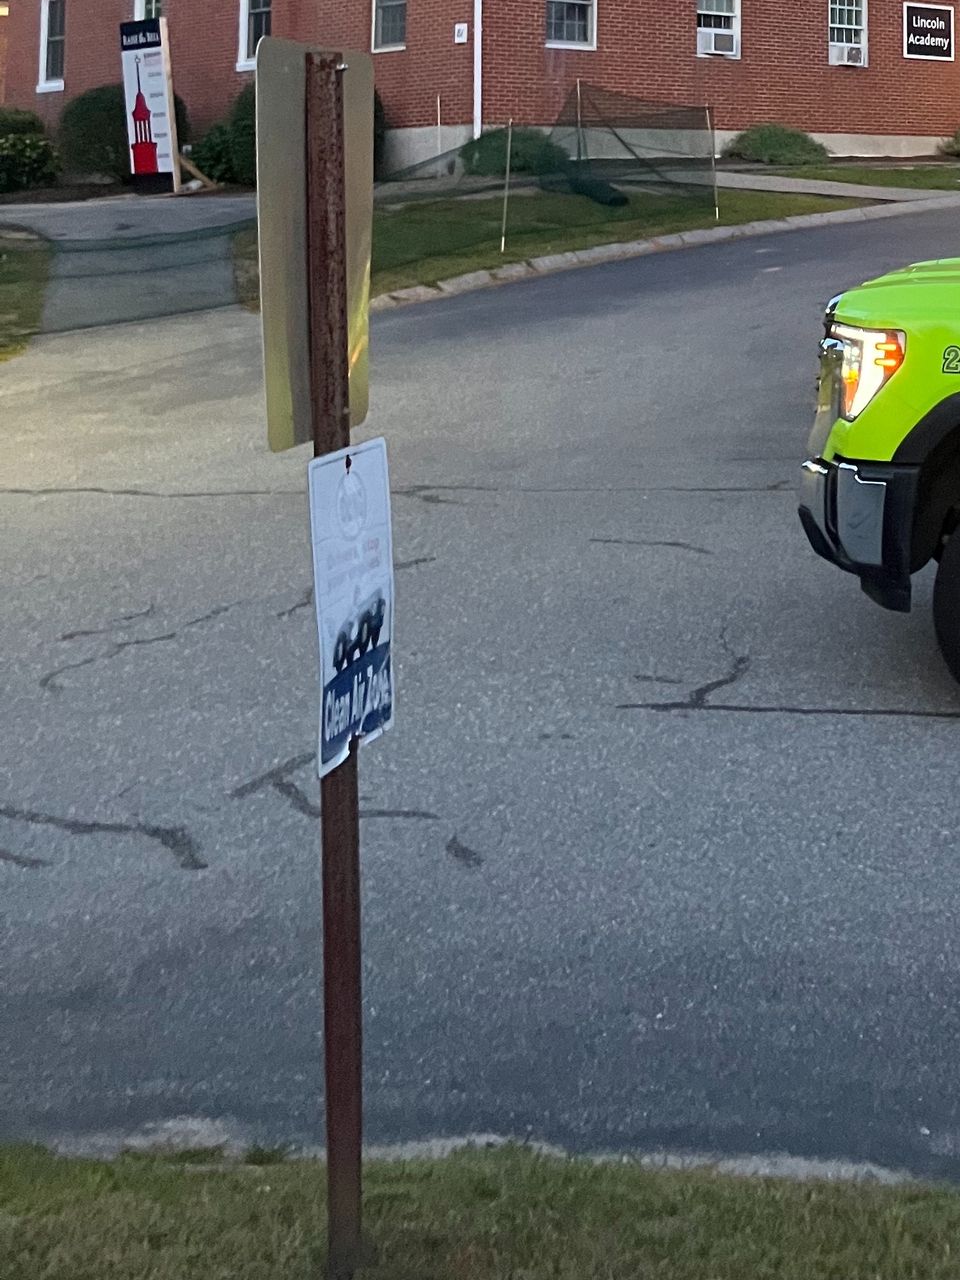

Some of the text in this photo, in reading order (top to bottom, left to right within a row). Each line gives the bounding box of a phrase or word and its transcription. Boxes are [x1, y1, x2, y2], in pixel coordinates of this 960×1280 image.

[913, 15, 945, 29] Lincoln
[908, 33, 949, 50] Academy
[325, 688, 350, 742] Clean
[351, 671, 366, 724] Air
